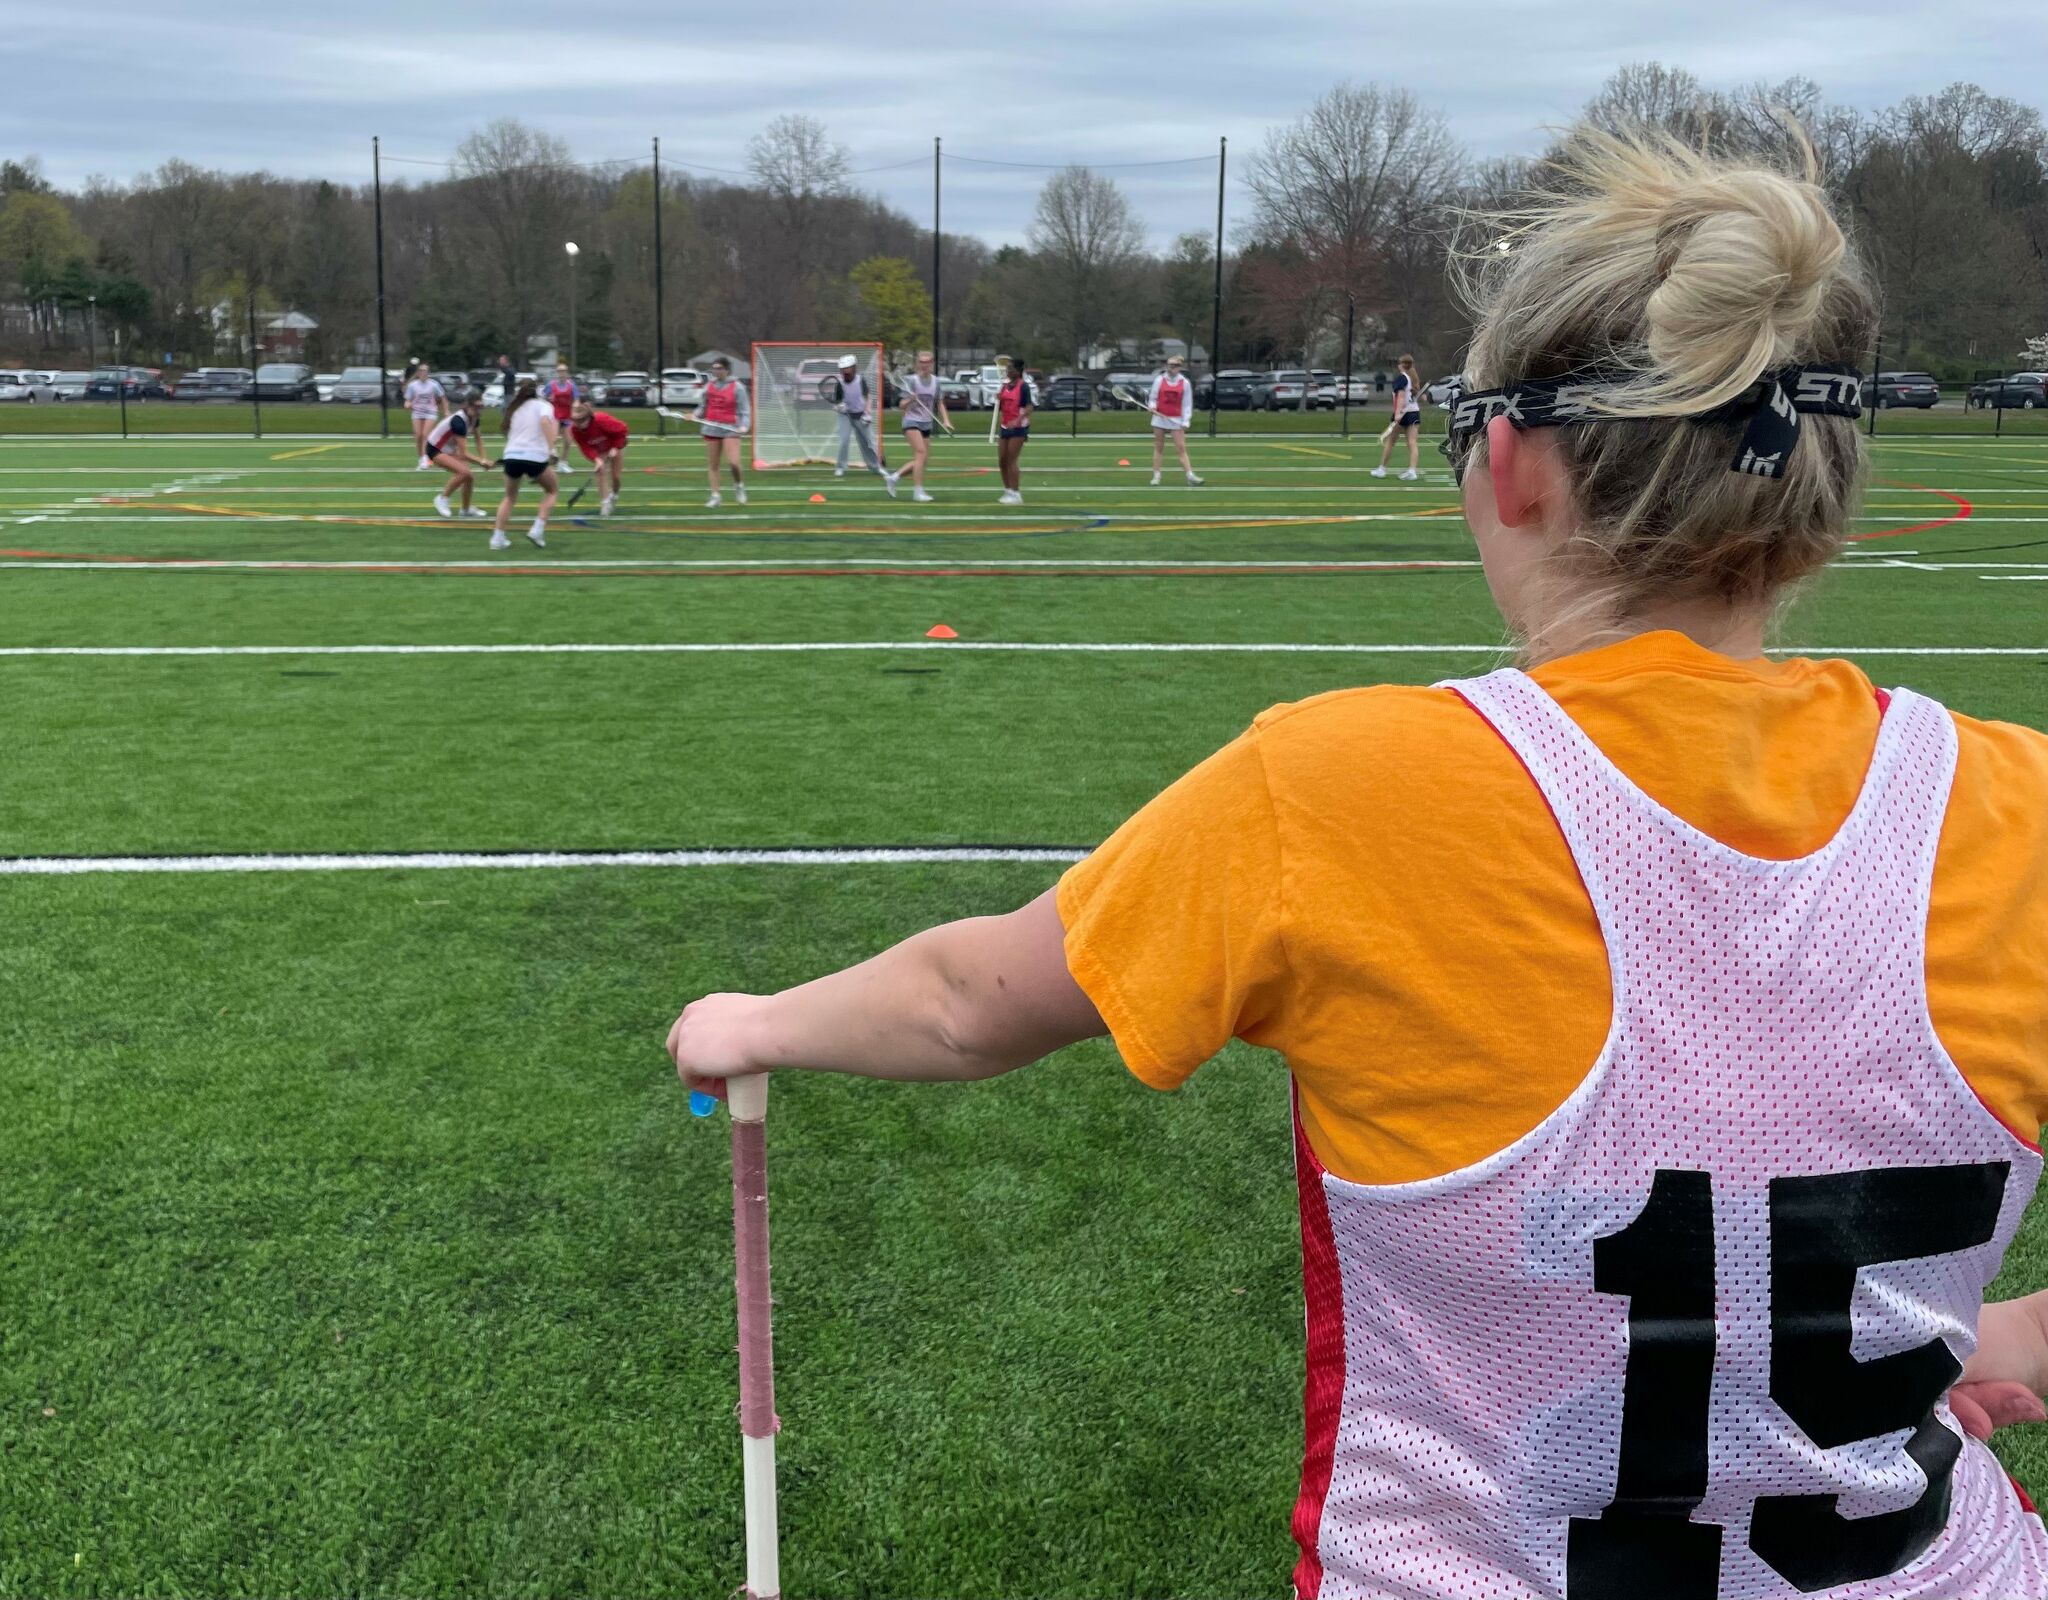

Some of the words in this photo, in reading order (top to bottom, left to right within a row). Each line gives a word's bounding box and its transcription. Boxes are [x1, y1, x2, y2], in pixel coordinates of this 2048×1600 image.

[1794, 371, 1863, 408] STX
[1453, 393, 1526, 429] STX
[1567, 1161, 2010, 1600] 15
